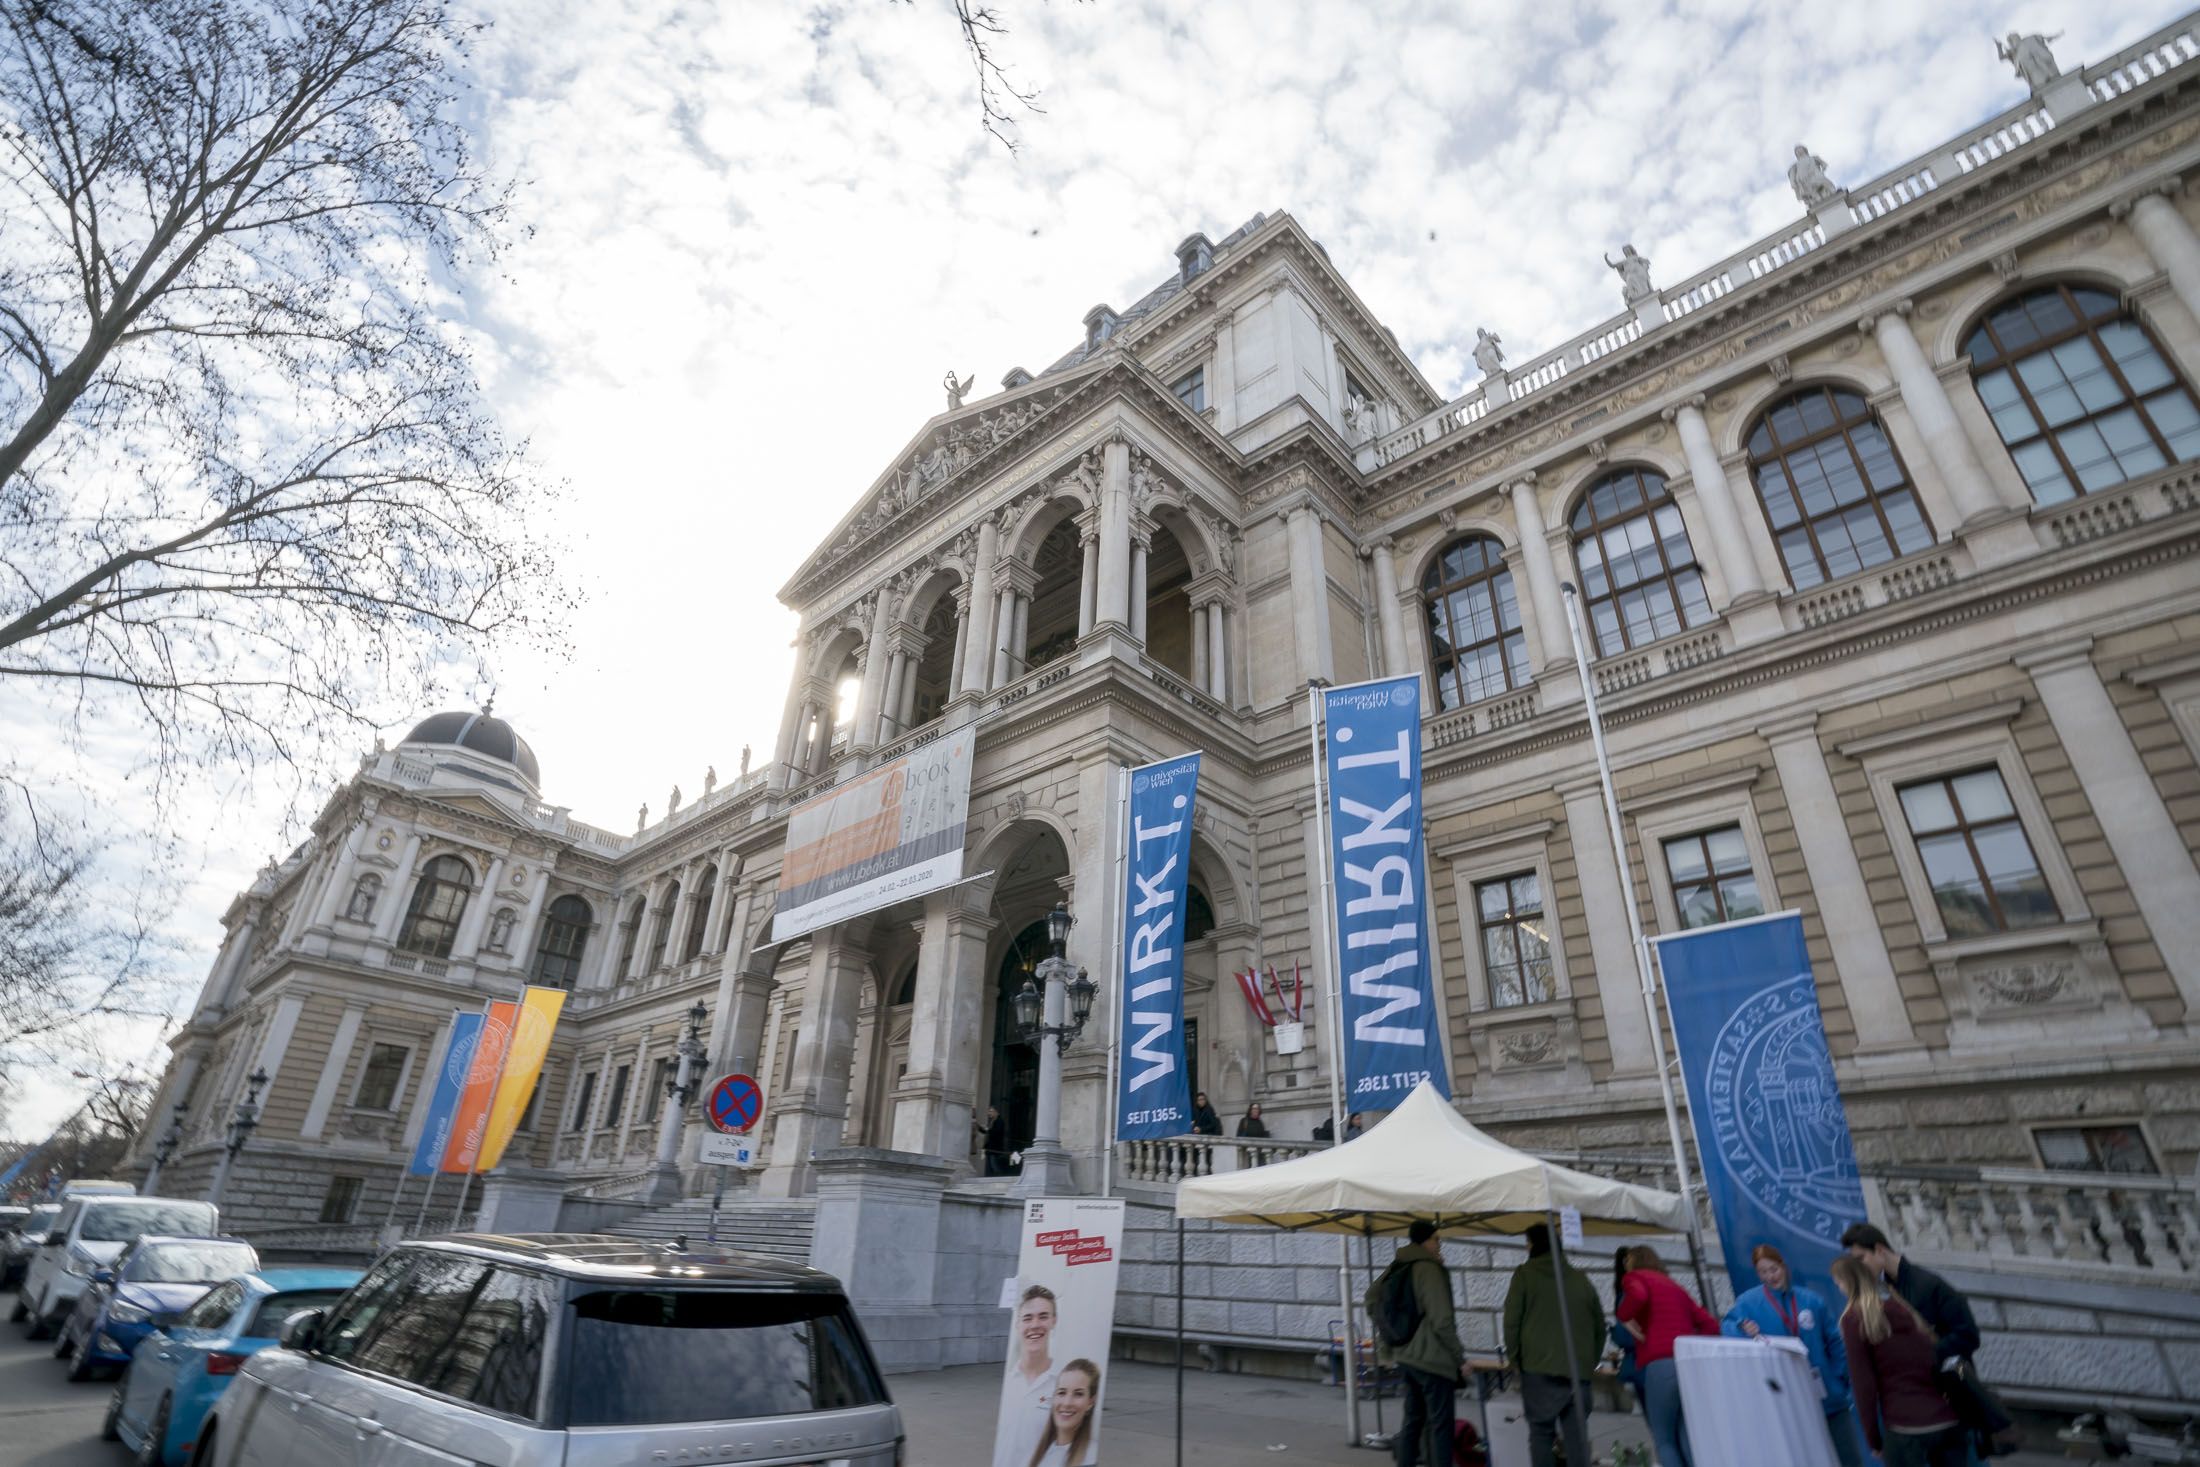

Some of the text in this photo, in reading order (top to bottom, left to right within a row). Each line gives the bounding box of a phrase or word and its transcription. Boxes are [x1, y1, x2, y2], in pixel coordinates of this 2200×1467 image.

[1150, 762, 1196, 782] universität
[1150, 777, 1174, 789] wien
[827, 852, 901, 892] www.ubook.at
[1129, 794, 1187, 1094] WIRKT.
[1126, 1107, 1183, 1125] SEIT 1365.
[652, 1432, 855, 1462] RANGE ROVER
